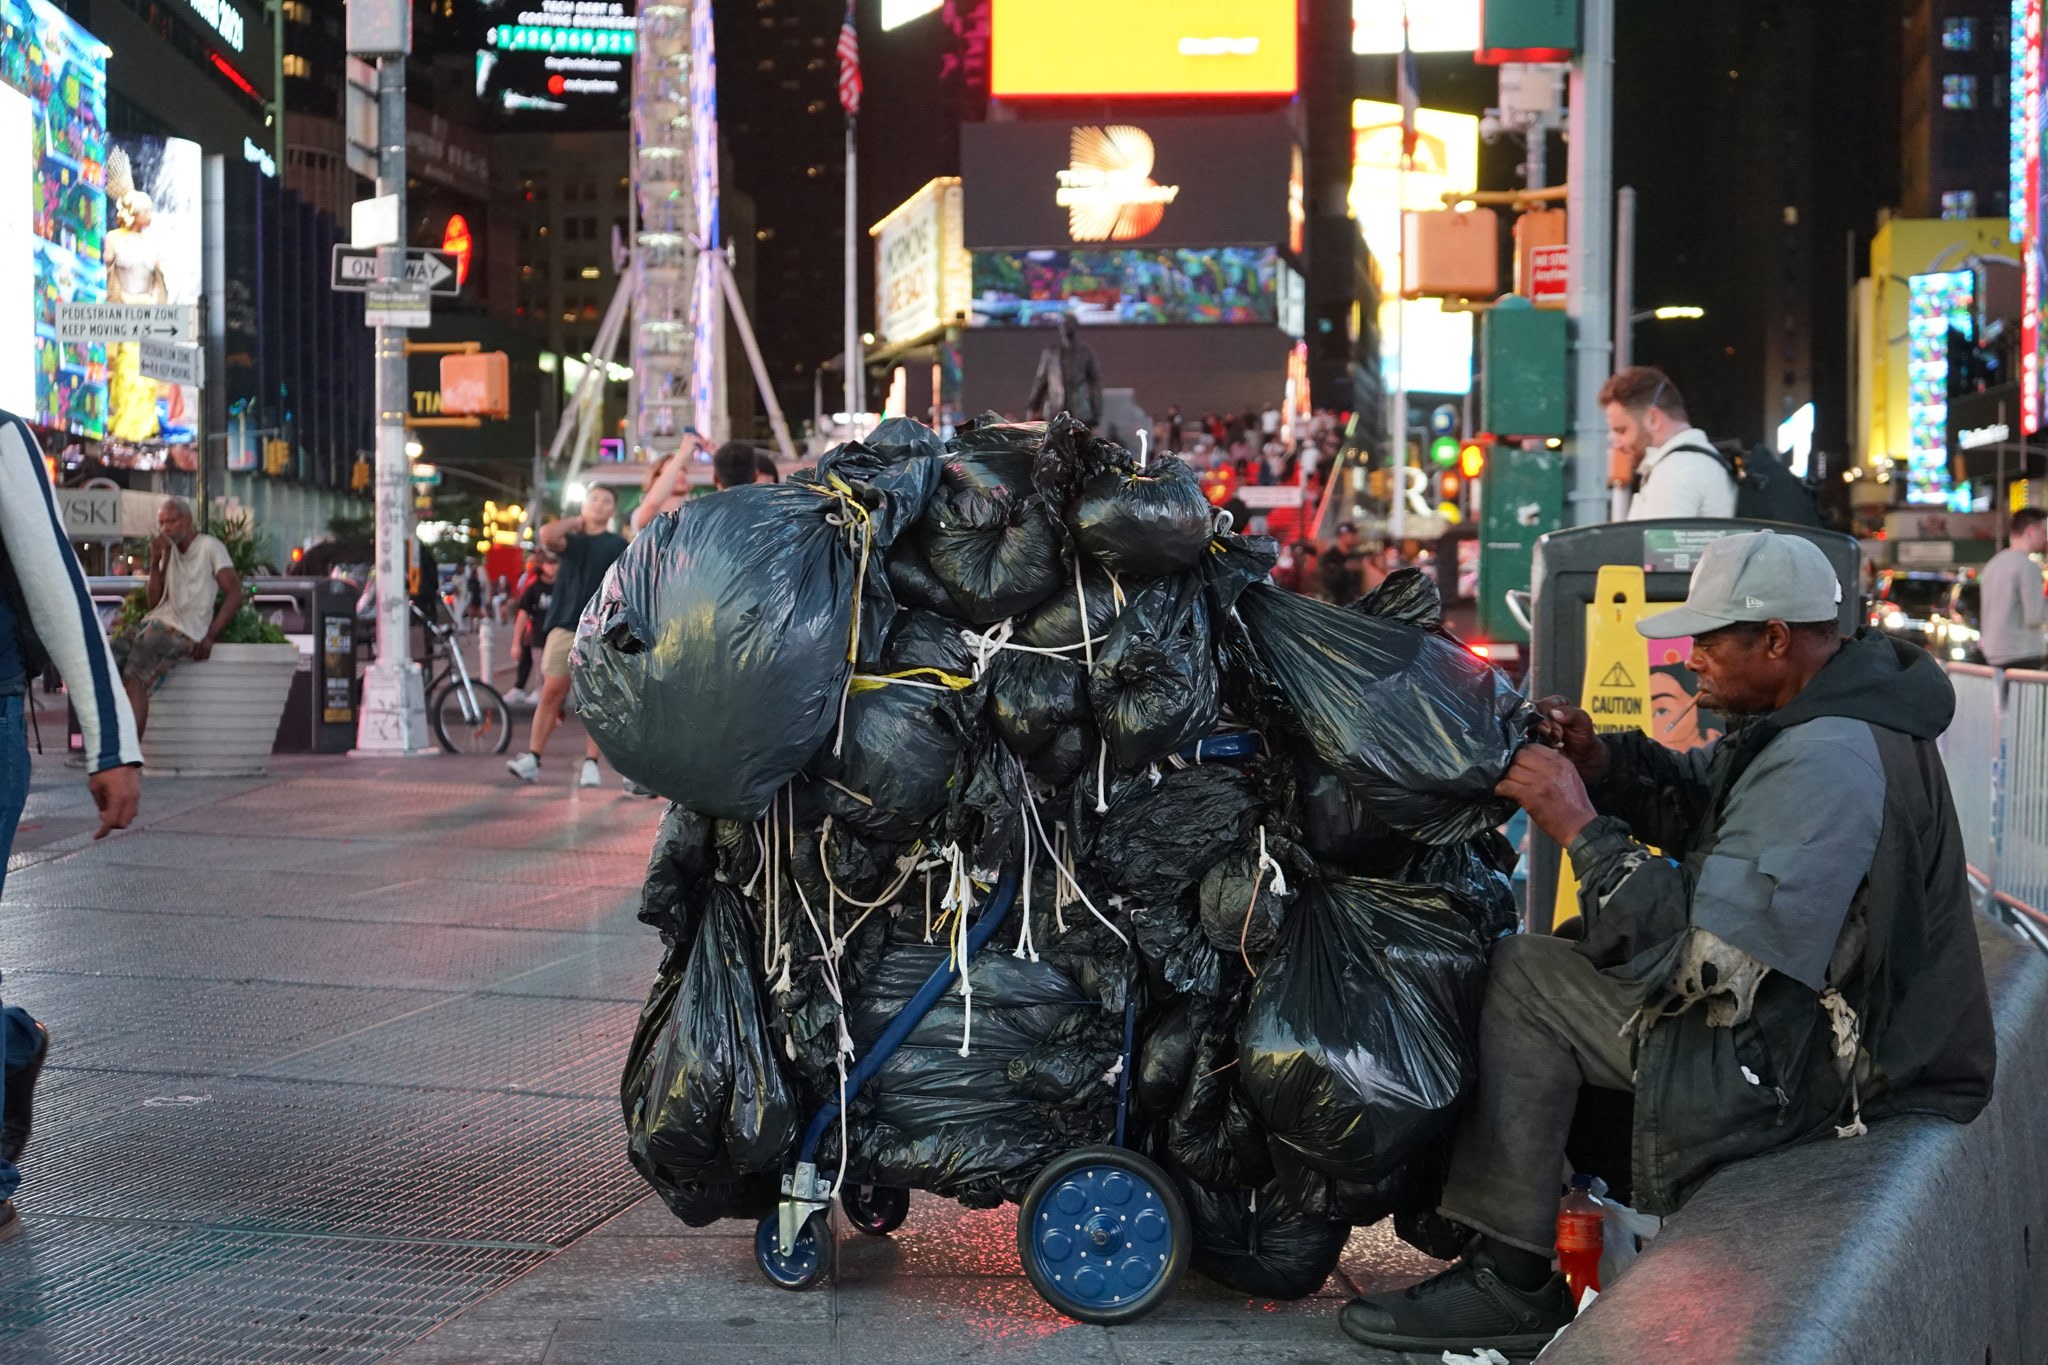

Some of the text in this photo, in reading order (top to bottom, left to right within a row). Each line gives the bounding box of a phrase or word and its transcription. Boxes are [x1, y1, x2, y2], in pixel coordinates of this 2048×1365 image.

[541, 0, 624, 17] TECH DEBT IS
[517, 11, 573, 28] COSTING
[352, 259, 376, 276] ON
[61, 307, 180, 320] PEDESTRIAN FLOW ZONE
[61, 323, 127, 336] KEEP MOVING
[1592, 696, 1642, 714] CAUTION
